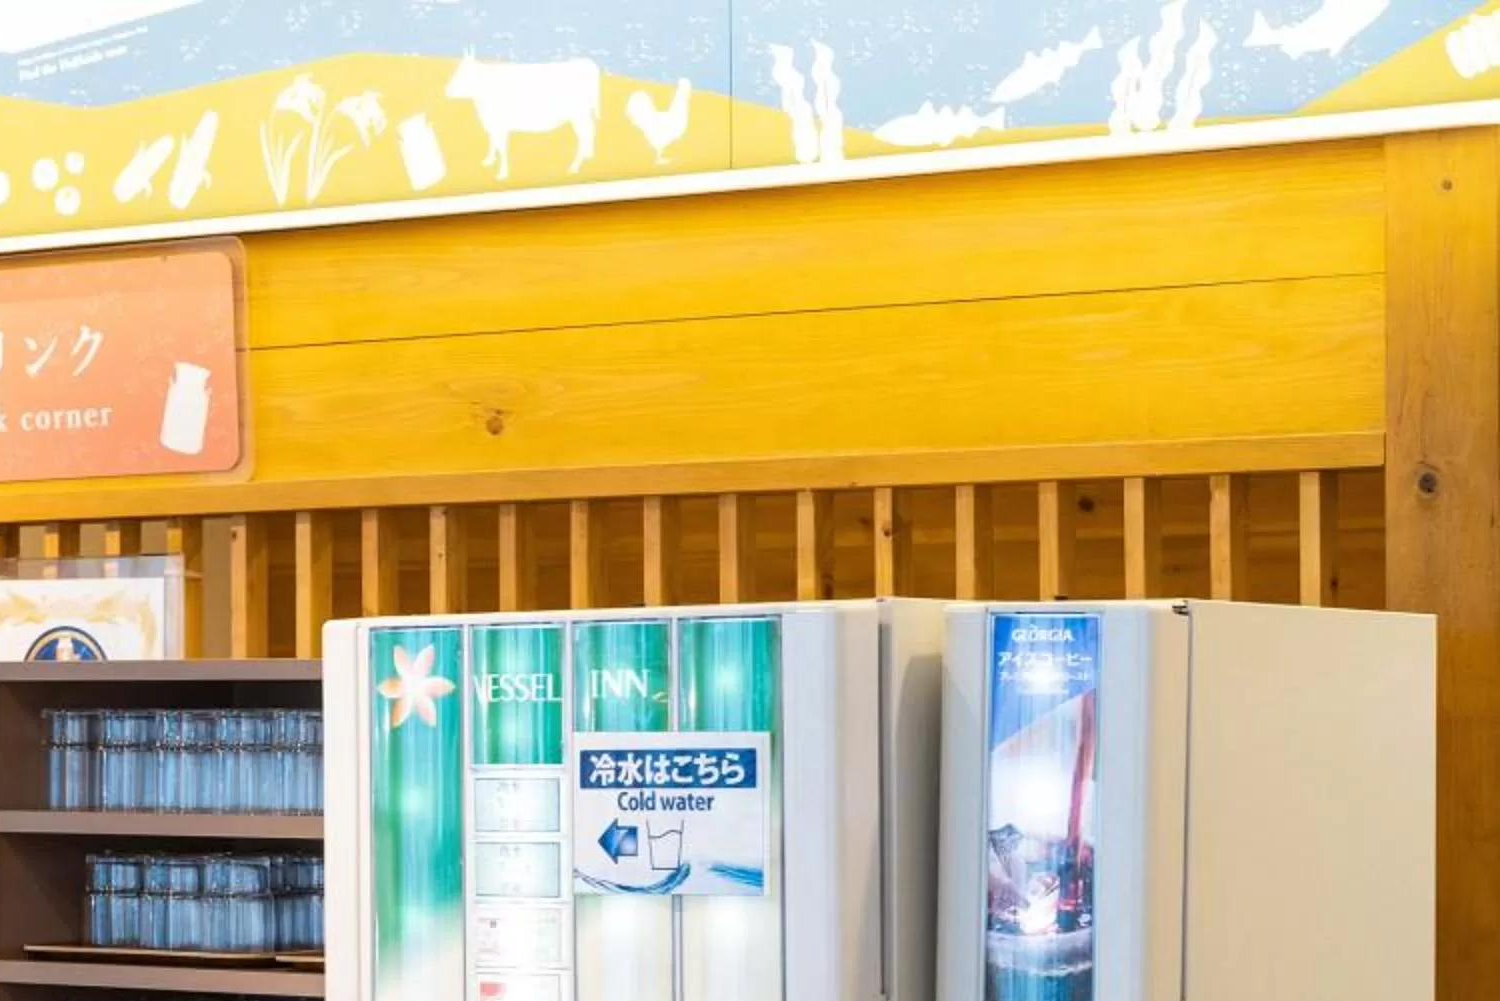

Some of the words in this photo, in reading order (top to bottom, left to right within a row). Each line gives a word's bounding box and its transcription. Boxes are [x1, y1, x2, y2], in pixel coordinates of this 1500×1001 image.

[20, 406, 113, 432] corner
[472, 673, 564, 704] VESSEL
[589, 669, 651, 699] INN
[589, 752, 745, 787] 冷水はこちら
[617, 791, 656, 811] Cold
[660, 793, 715, 811] water
